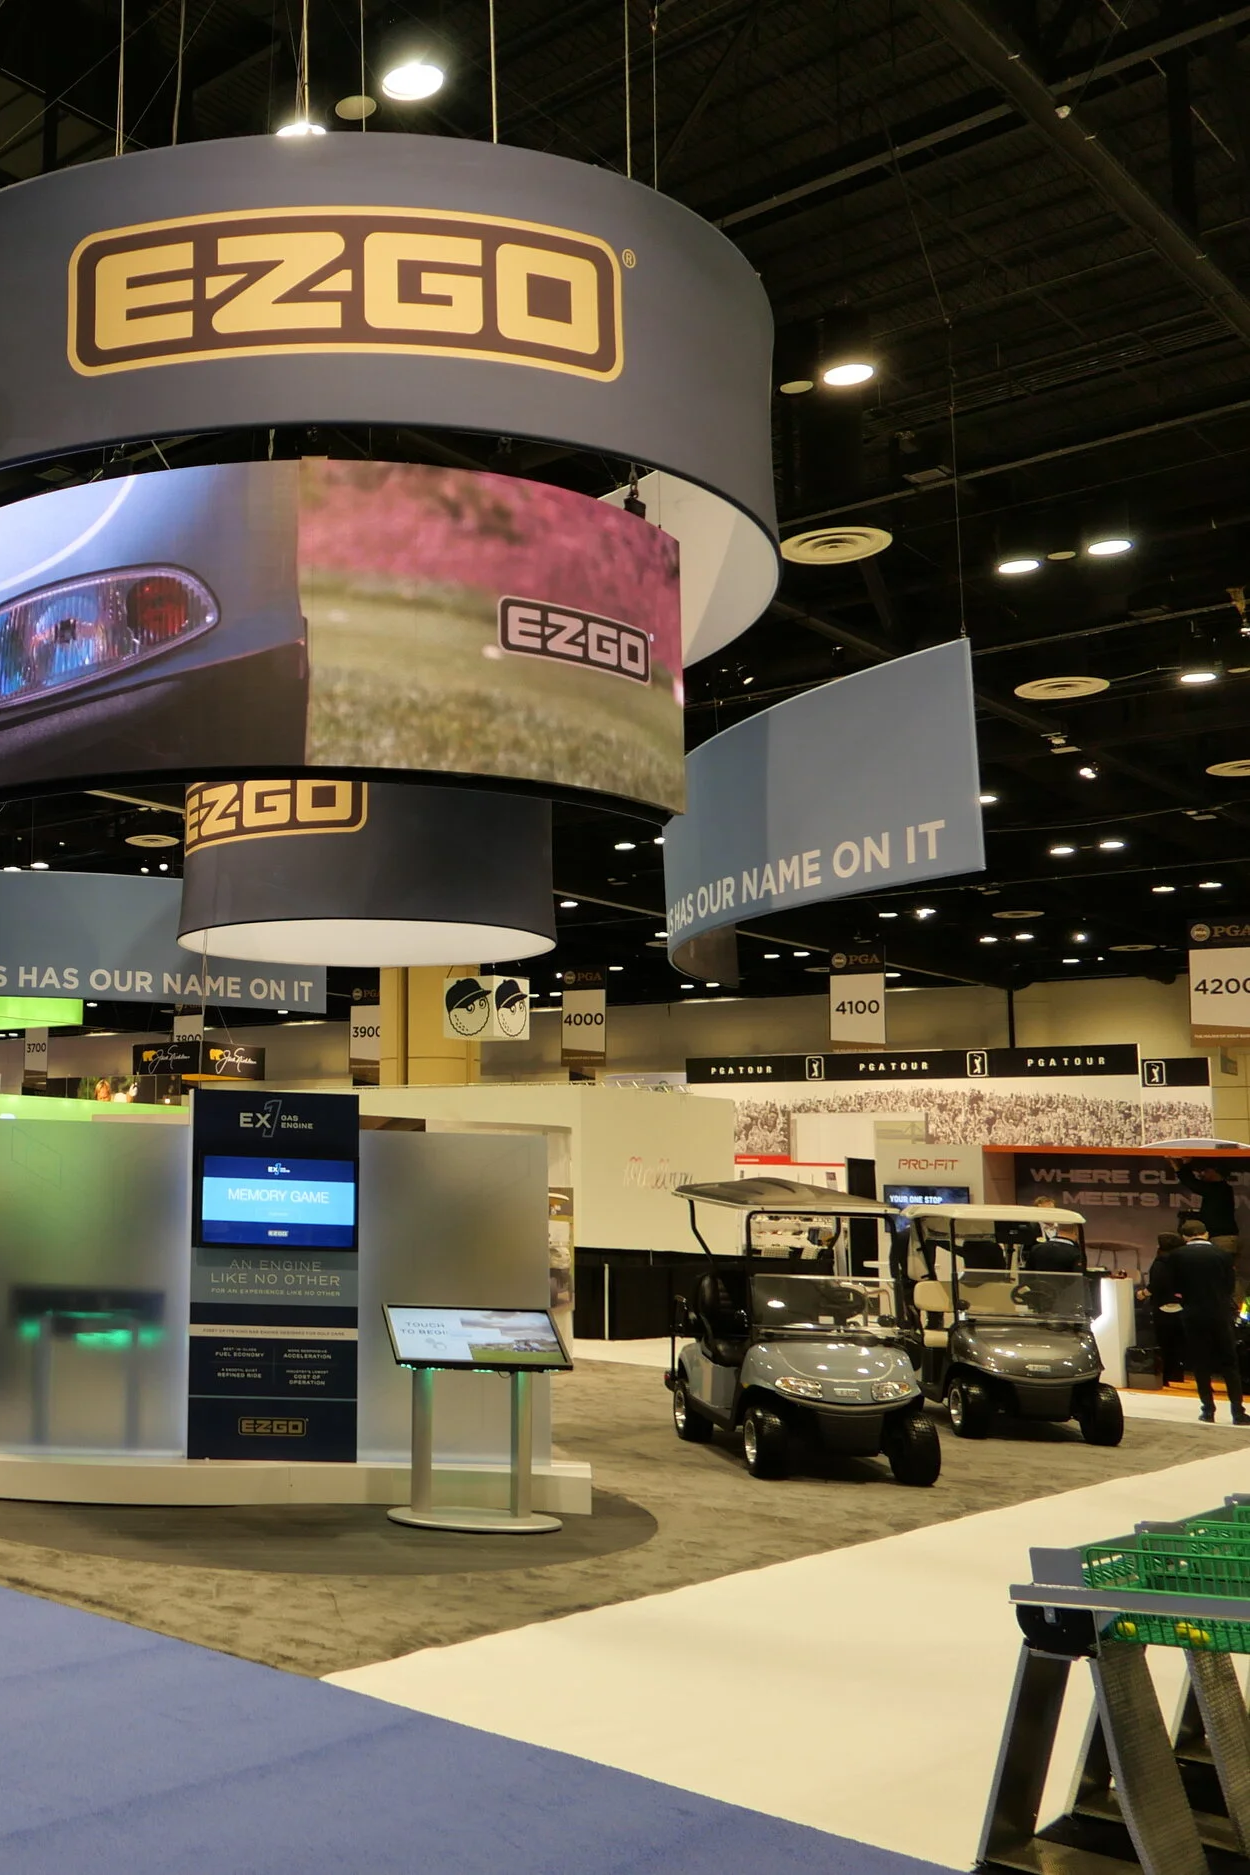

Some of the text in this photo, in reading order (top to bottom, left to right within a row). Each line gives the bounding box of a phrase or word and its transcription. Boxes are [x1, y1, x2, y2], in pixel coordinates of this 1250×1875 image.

[94, 231, 600, 355] EZGO
[507, 605, 645, 676] EZGO
[186, 779, 353, 846] EZGO
[673, 893, 695, 934] HAS
[697, 876, 735, 919] OUR
[742, 849, 822, 904] NAME
[832, 831, 890, 879] ON
[906, 819, 946, 865] IT
[849, 953, 881, 965] PGA
[577, 971, 602, 982] PGA
[18, 966, 80, 990] HAS
[89, 968, 153, 993] OUR
[163, 972, 242, 999] NAME
[249, 977, 286, 1001] ON
[293, 980, 313, 1002] IT
[835, 999, 880, 1015] 4100
[564, 1012, 604, 1026] 4000
[26, 1042, 47, 1054] 3700
[859, 1061, 930, 1072] PGA TOUR
[1027, 1055, 1107, 1068] PGA TOUR
[711, 1065, 773, 1075] PGA TOUR
[281, 1114, 299, 1122] GAS
[281, 1122, 314, 1130] ENGINE
[1030, 1168, 1131, 1185] WHERE
[228, 1187, 330, 1205] MEMORY GAME
[889, 1195, 943, 1204] YOUR ONE STOP
[1062, 1190, 1160, 1208] MEETS
[229, 1259, 322, 1272] AN ENGINE
[211, 1272, 341, 1286] LIKE NO OTHER
[240, 1288, 285, 1296] EXPERIENCE
[405, 1321, 446, 1329] TOUCH
[283, 1352, 332, 1360] ACCELERATION
[289, 1379, 326, 1387] OPERATION
[241, 1419, 304, 1434] EZGO
